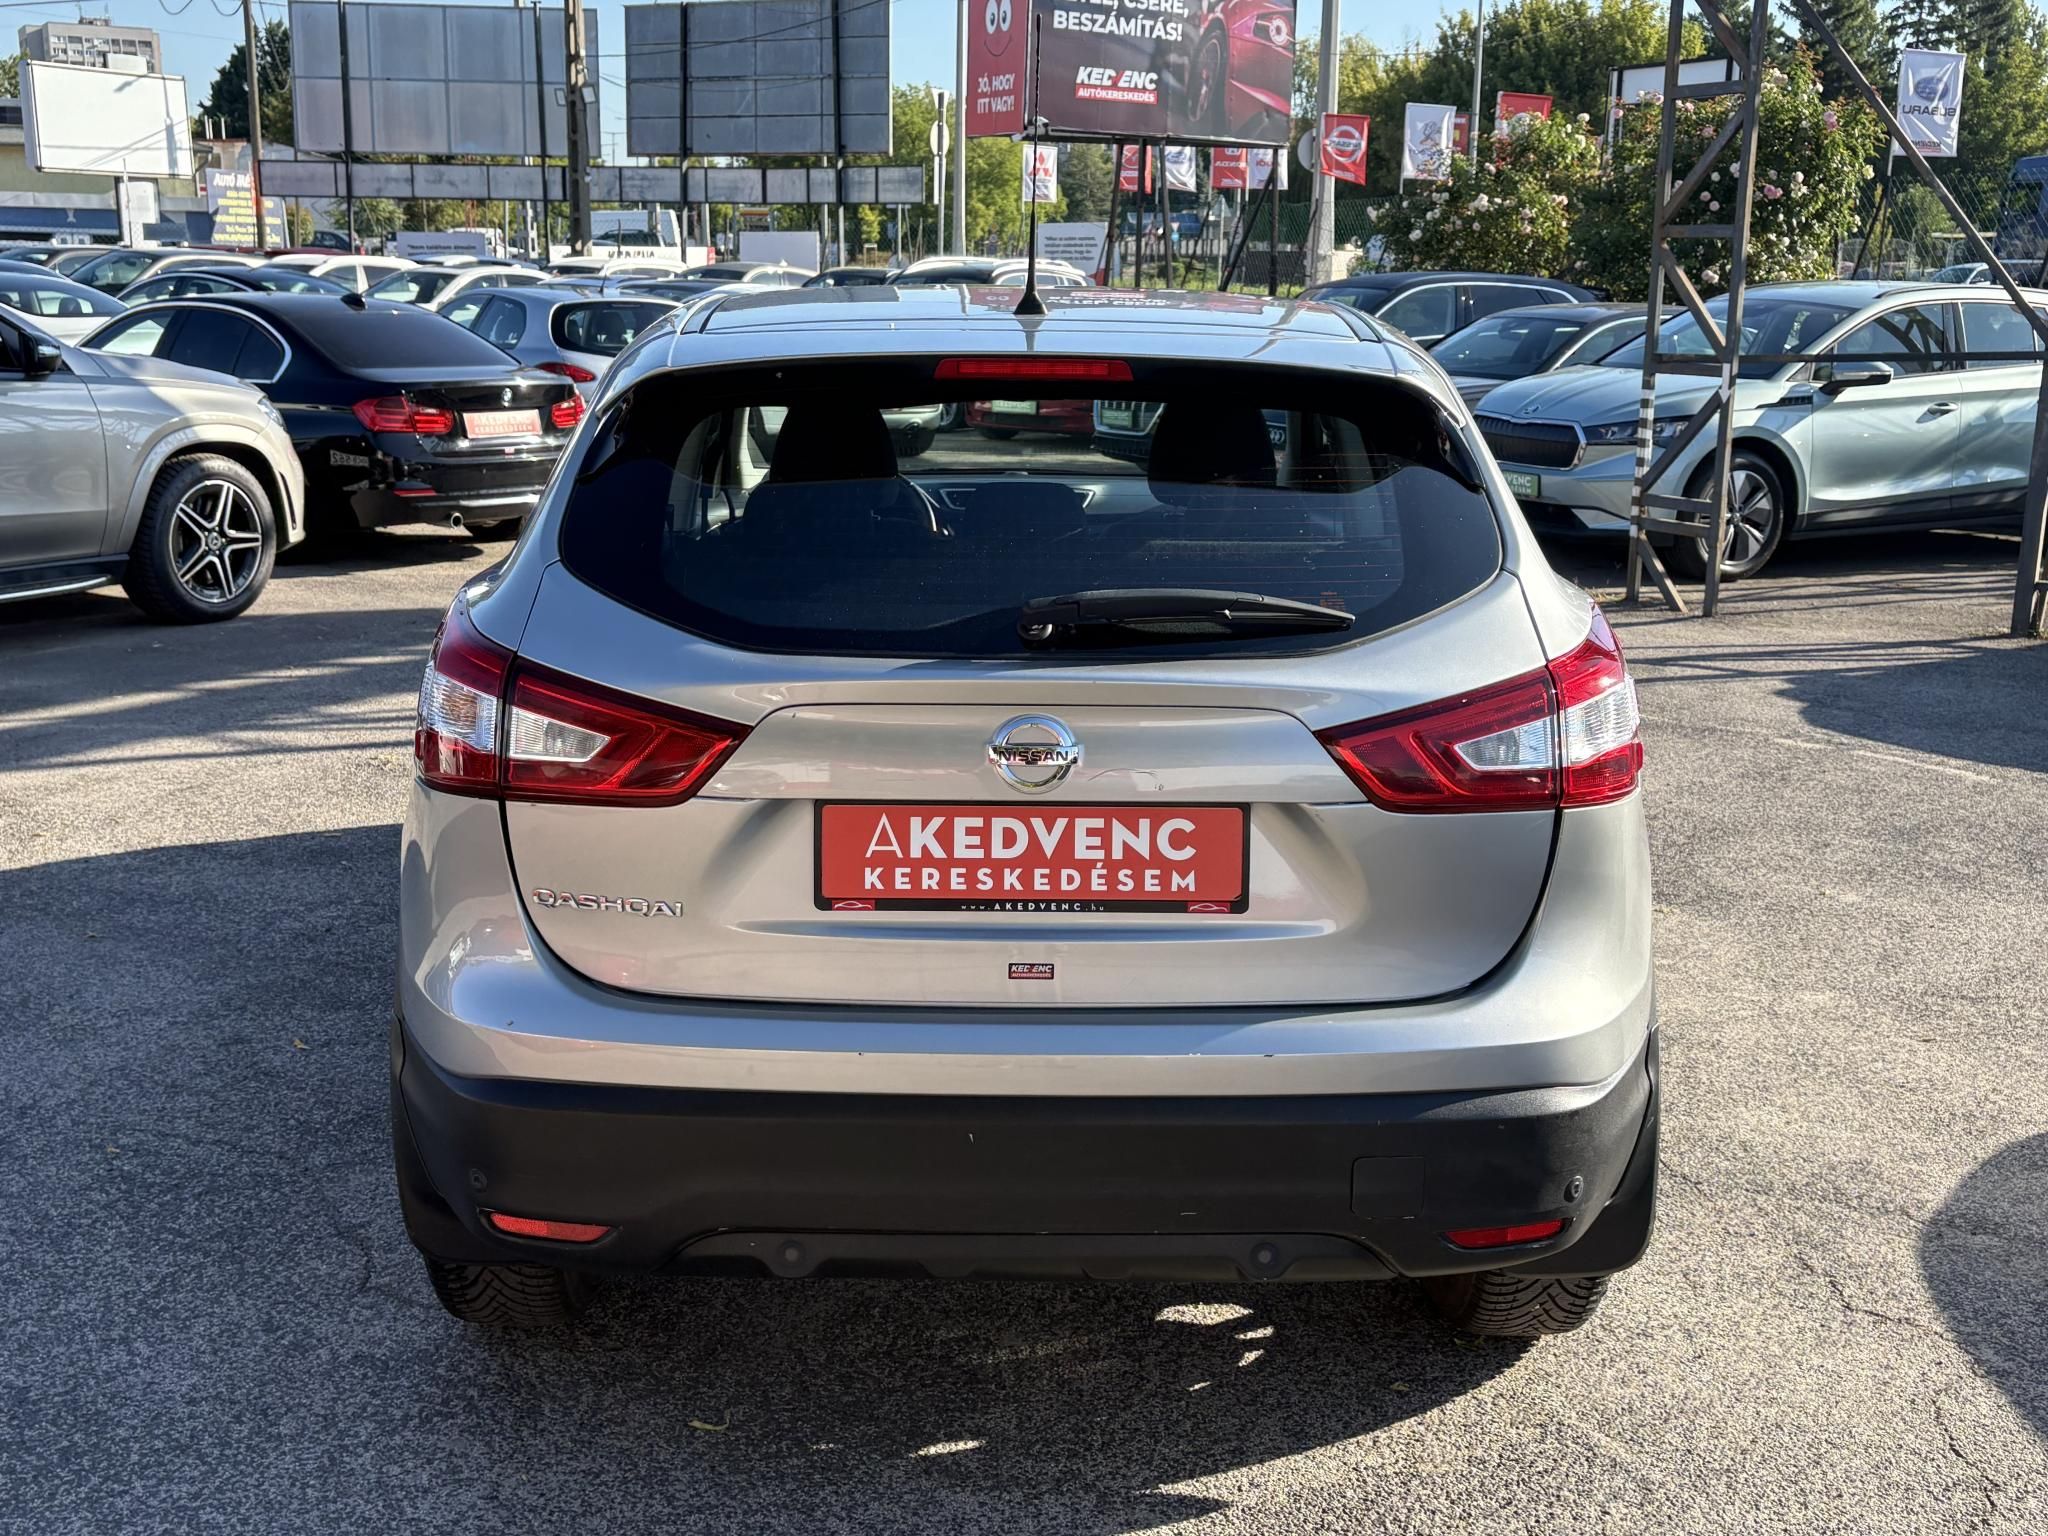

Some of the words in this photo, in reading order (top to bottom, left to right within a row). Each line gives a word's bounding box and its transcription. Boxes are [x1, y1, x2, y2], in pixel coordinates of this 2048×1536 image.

[1053, 10, 1183, 41] BESZÁMÍTÁS!
[977, 73, 991, 95] JÓ,
[992, 72, 1016, 92] HOGY
[1077, 87, 1156, 103] AUTÓKERESKEDÉS
[977, 98, 990, 114] ITT
[990, 95, 1015, 113] VAGY!
[1000, 750, 1069, 762] NISSAN
[865, 812, 1197, 861] AKEDVENC
[864, 862, 1197, 893] KERESKEDÉSEM
[532, 888, 684, 917] QASHQAI
[961, 902, 1104, 911] www.AKEDVENC.hu
